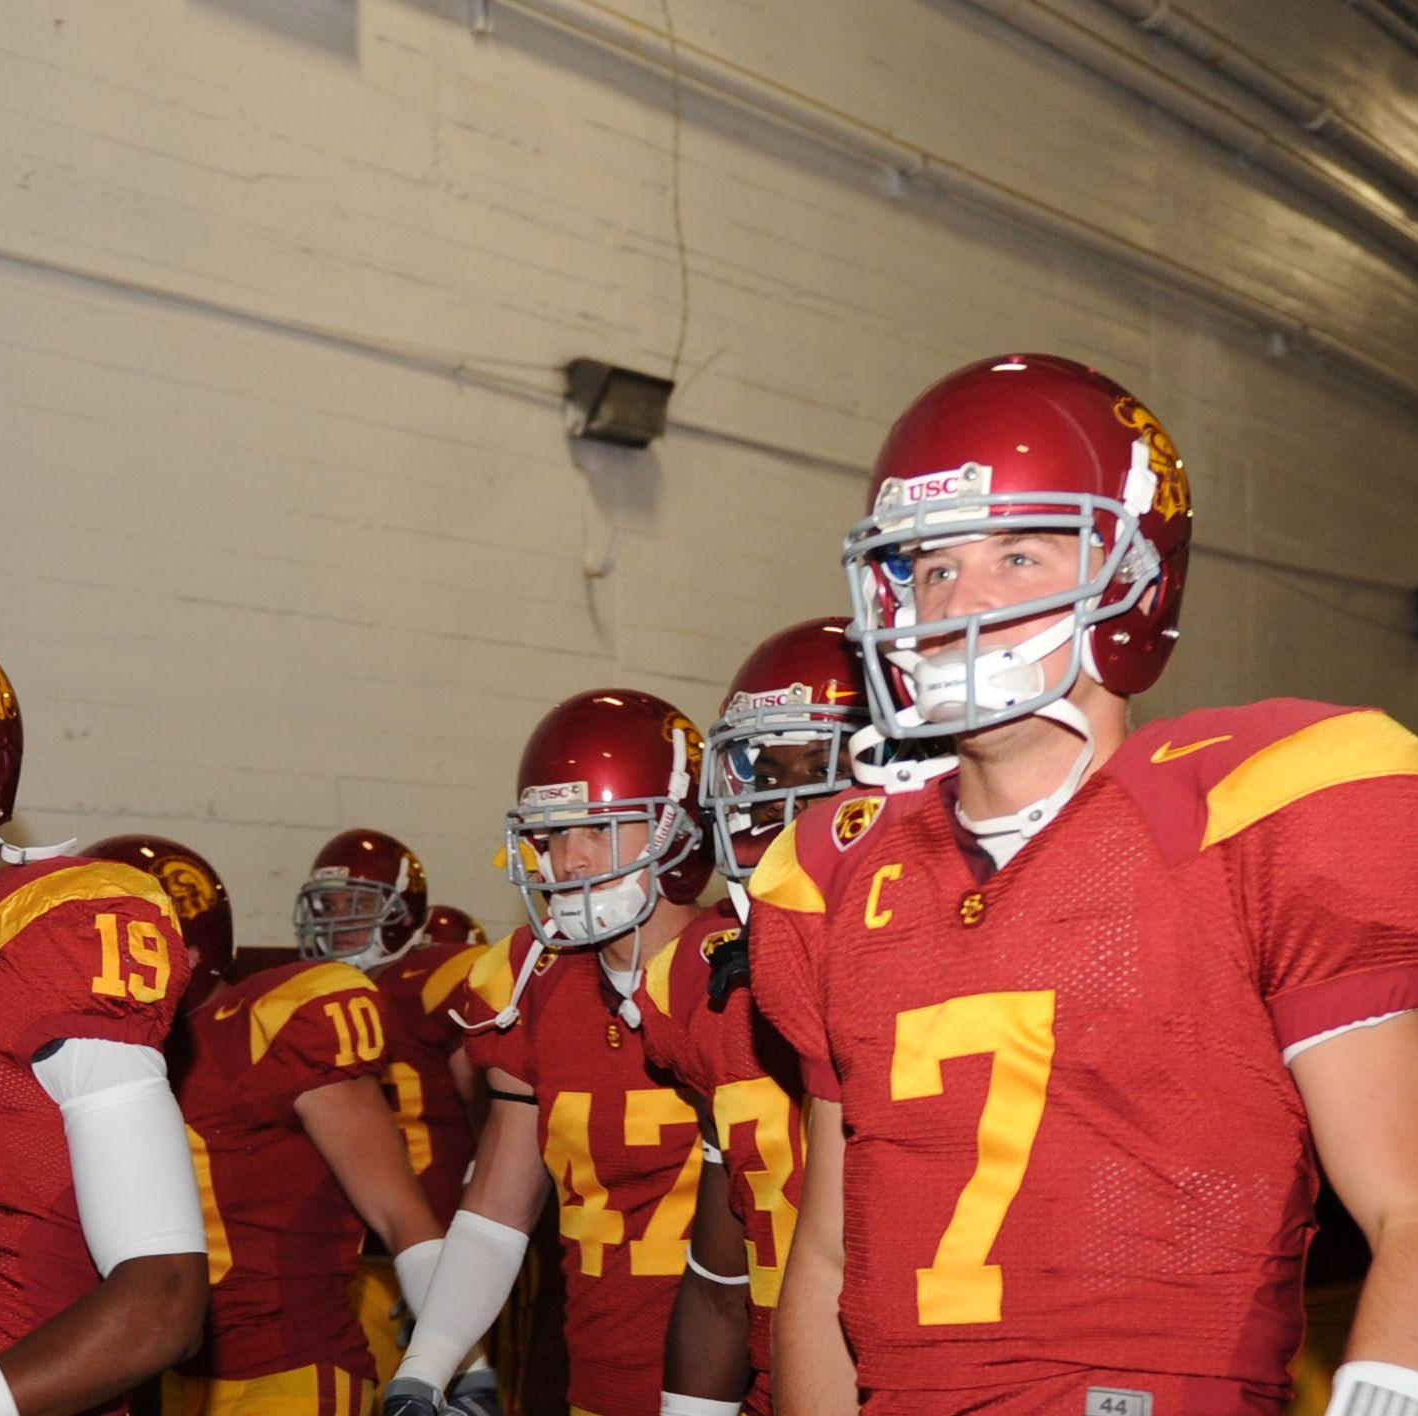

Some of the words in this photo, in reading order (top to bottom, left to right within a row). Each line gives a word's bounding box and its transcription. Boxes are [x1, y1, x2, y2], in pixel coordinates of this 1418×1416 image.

[908, 477, 959, 502] USC
[752, 694, 789, 709] USC
[539, 786, 569, 800] USC
[864, 863, 904, 930] C
[91, 913, 173, 1004] 19
[323, 996, 385, 1067] 10
[542, 1089, 703, 1278] 47
[890, 987, 1056, 1326] 7
[1099, 1397, 1127, 1416] 44
